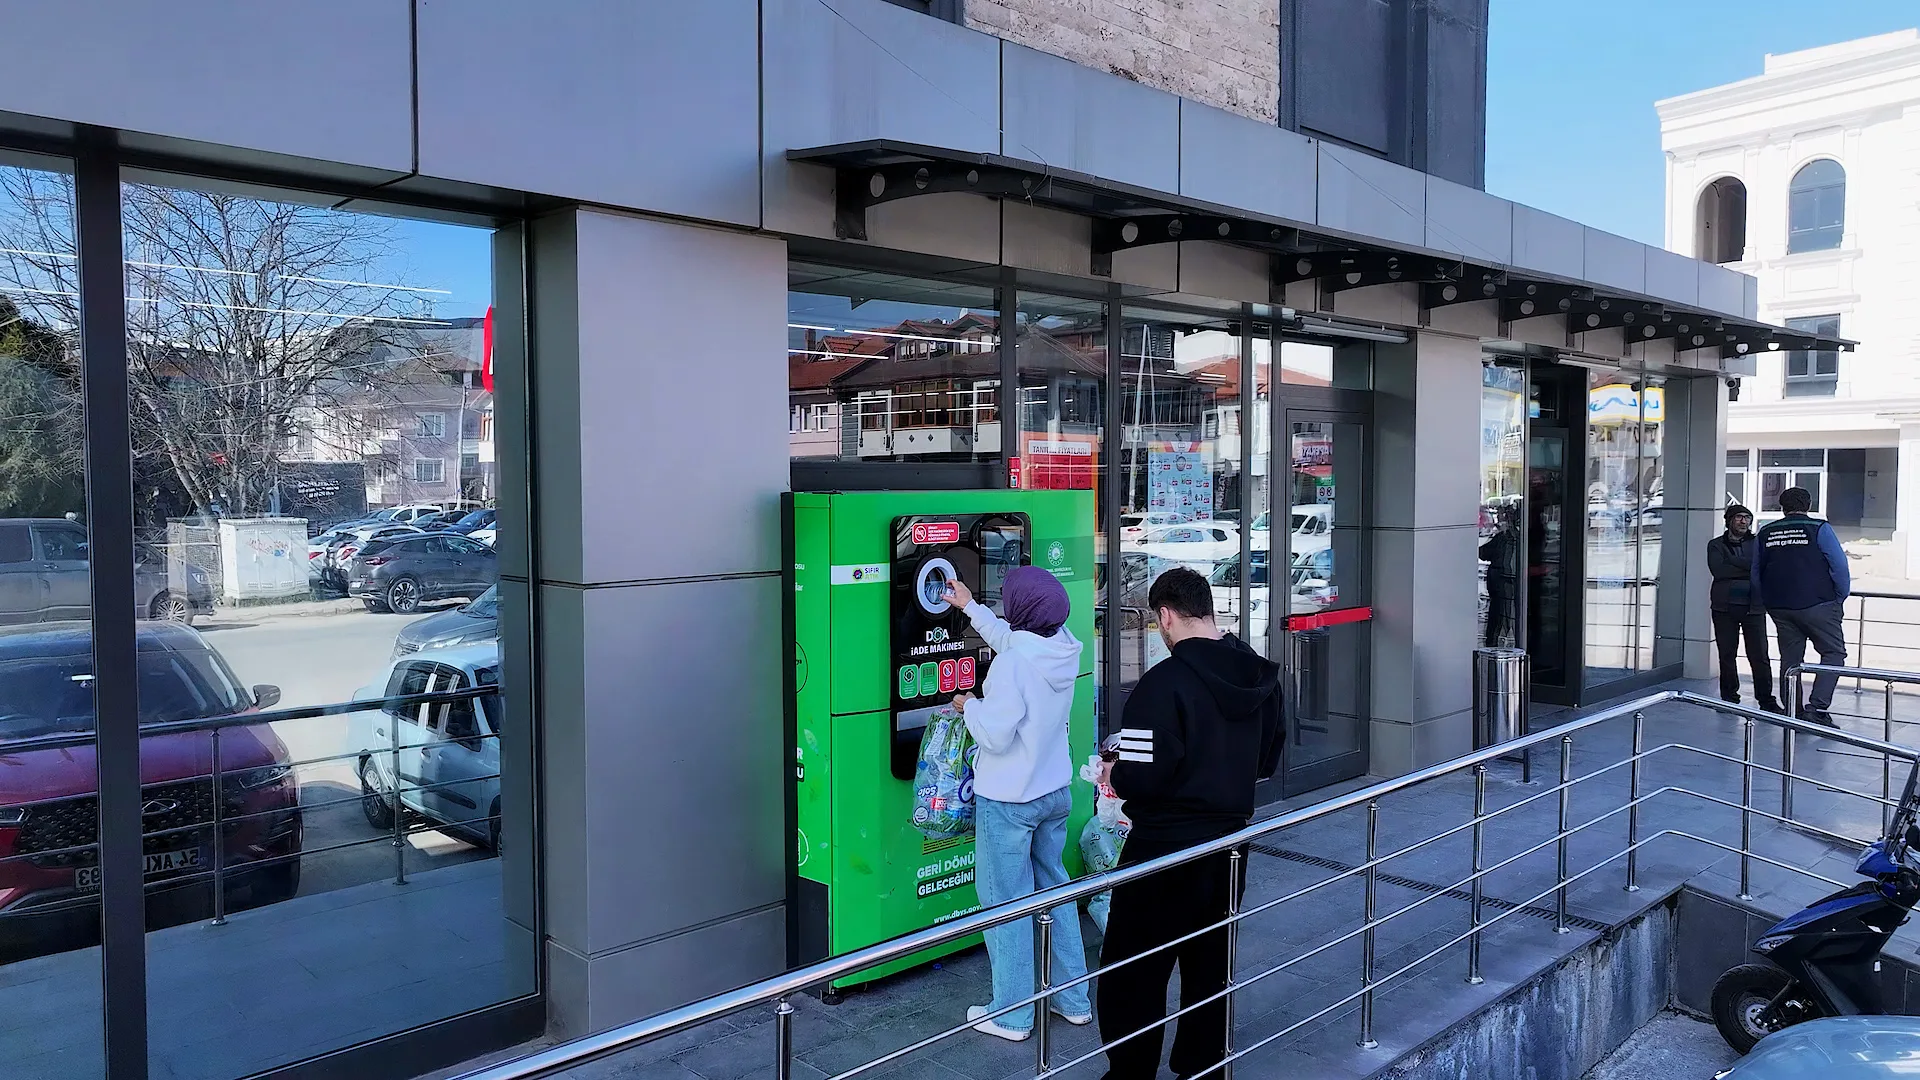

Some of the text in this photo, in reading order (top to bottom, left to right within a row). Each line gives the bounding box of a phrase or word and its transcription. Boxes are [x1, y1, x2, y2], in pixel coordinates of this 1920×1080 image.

[929, 641, 965, 653] MAKİNESİ
[916, 851, 976, 879] GERİ DÖNÜ
[918, 868, 974, 896] GELECEĞİNİ
